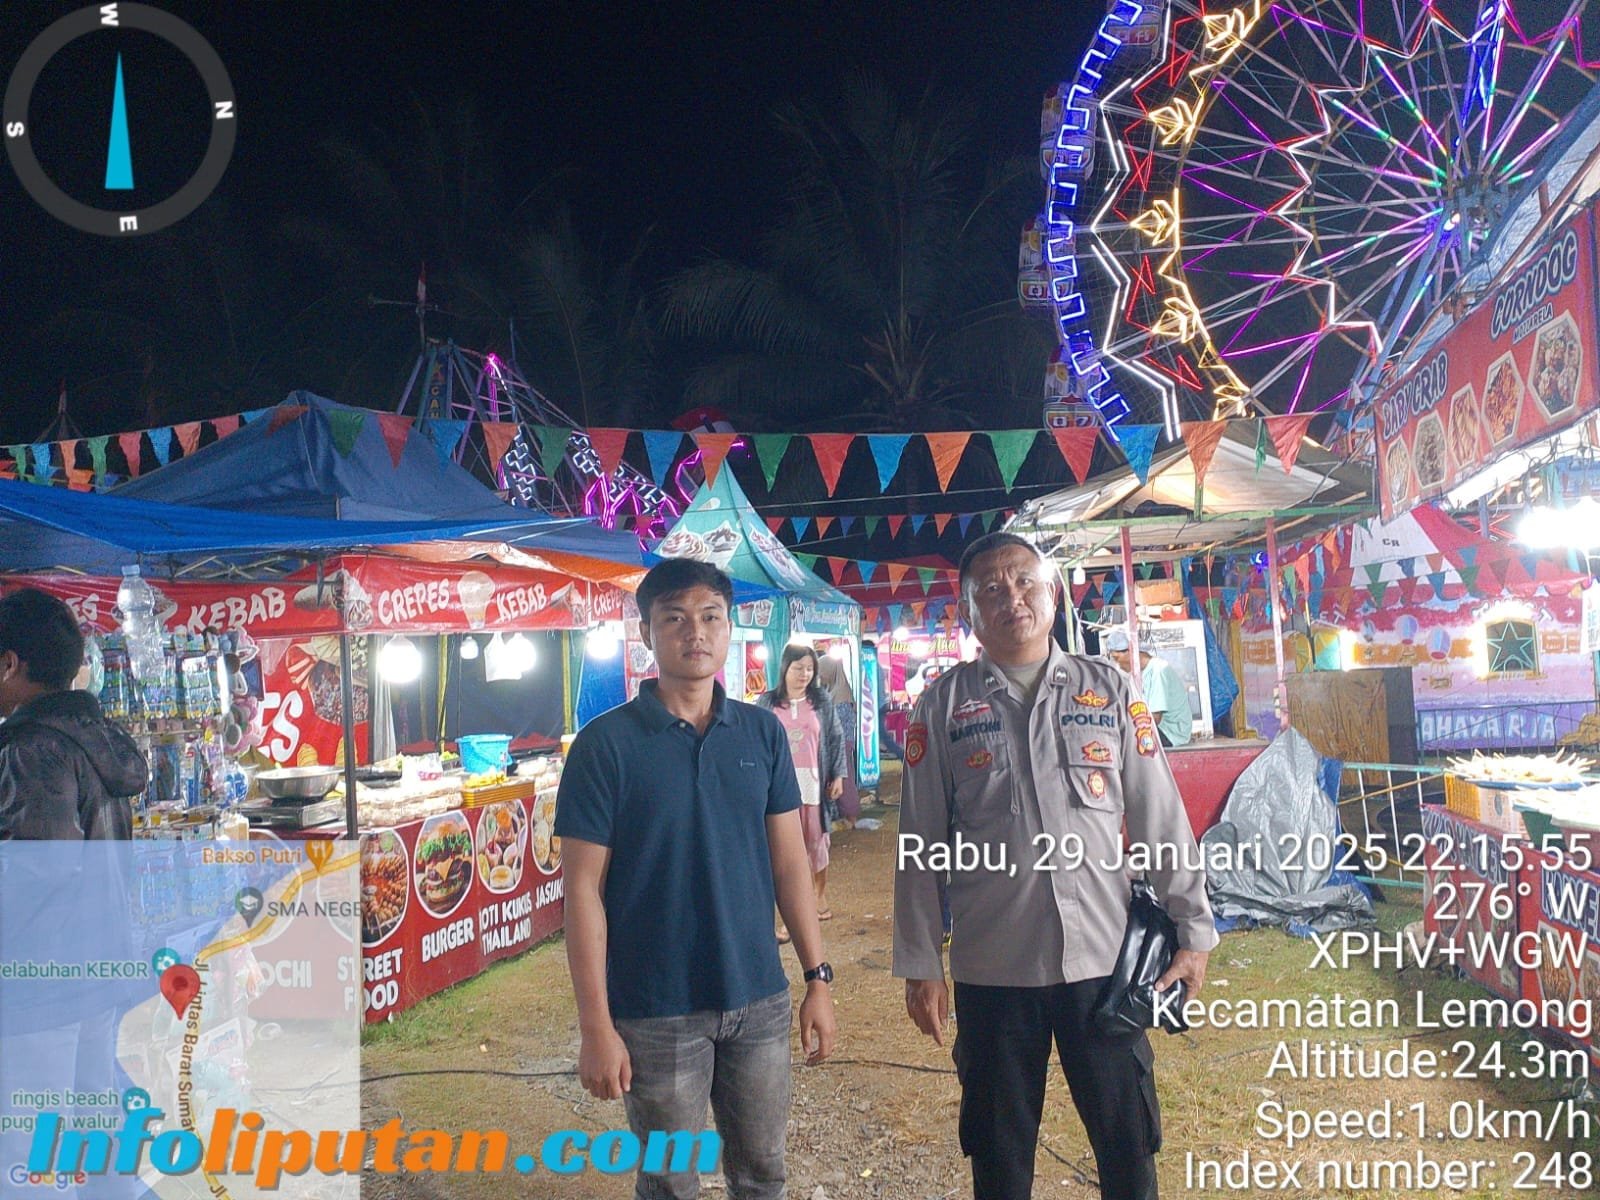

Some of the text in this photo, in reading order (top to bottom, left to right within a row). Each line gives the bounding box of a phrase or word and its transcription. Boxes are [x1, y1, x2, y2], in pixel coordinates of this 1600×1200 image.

[1491, 231, 1577, 339] CORNDOG
[1383, 381, 1412, 440] BABY
[187, 587, 286, 631] KEBAB
[377, 578, 547, 625] CREPES KEBAB
[1061, 714, 1115, 728] POLRI
[422, 917, 475, 963] BURGER
[482, 918, 532, 957] THAILAND
[337, 948, 403, 984] STREET
[344, 980, 399, 1012] FOOD
